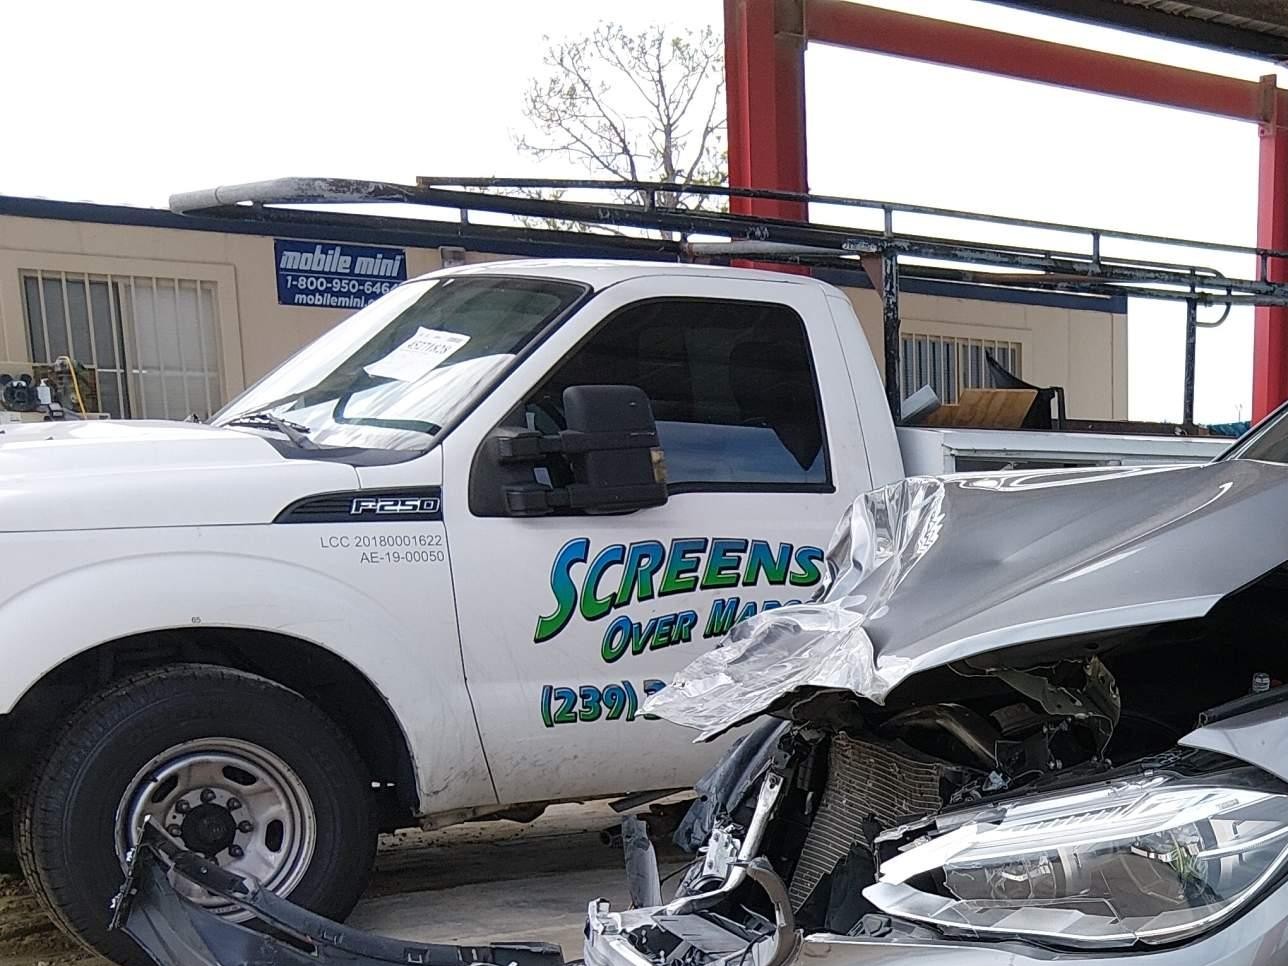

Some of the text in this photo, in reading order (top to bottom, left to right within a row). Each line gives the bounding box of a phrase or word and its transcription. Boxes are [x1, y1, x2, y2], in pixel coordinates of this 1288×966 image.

[280, 245, 402, 277] mobile mini
[350, 498, 440, 514] F-250
[320, 535, 442, 548] LCC 20180001622
[360, 550, 445, 564] AE-19-00050
[540, 680, 639, 728] (239)
